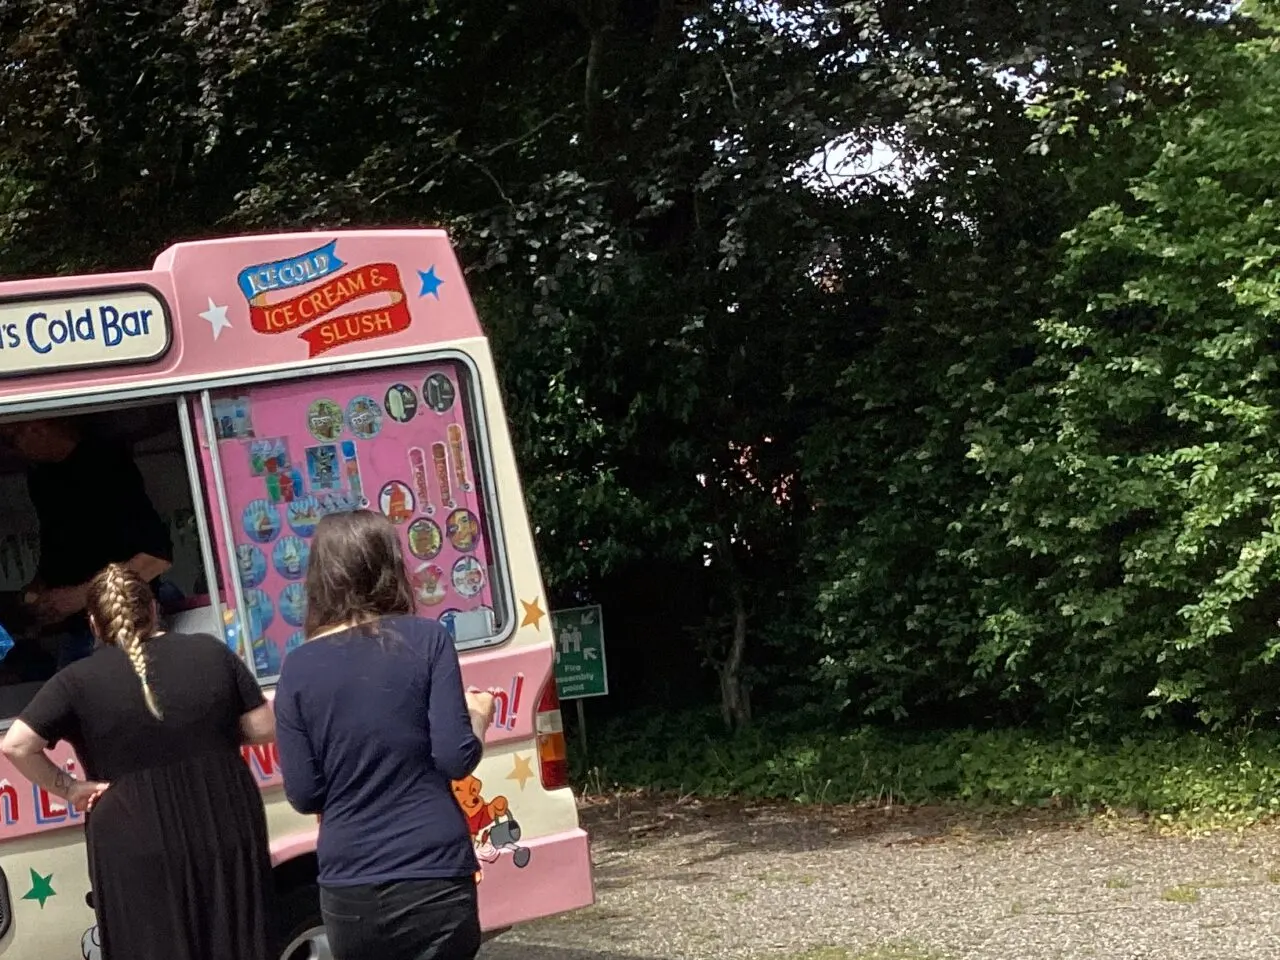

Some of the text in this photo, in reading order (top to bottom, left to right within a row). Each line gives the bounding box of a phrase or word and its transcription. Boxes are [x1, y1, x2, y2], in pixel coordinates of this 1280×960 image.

[247, 252, 329, 294] ICE COLD
[264, 268, 388, 331] ICE CREAM &
[25, 308, 96, 354] Cold
[99, 304, 153, 348] Bar
[320, 312, 393, 345] SLUSH
[564, 664, 582, 673] Fire
